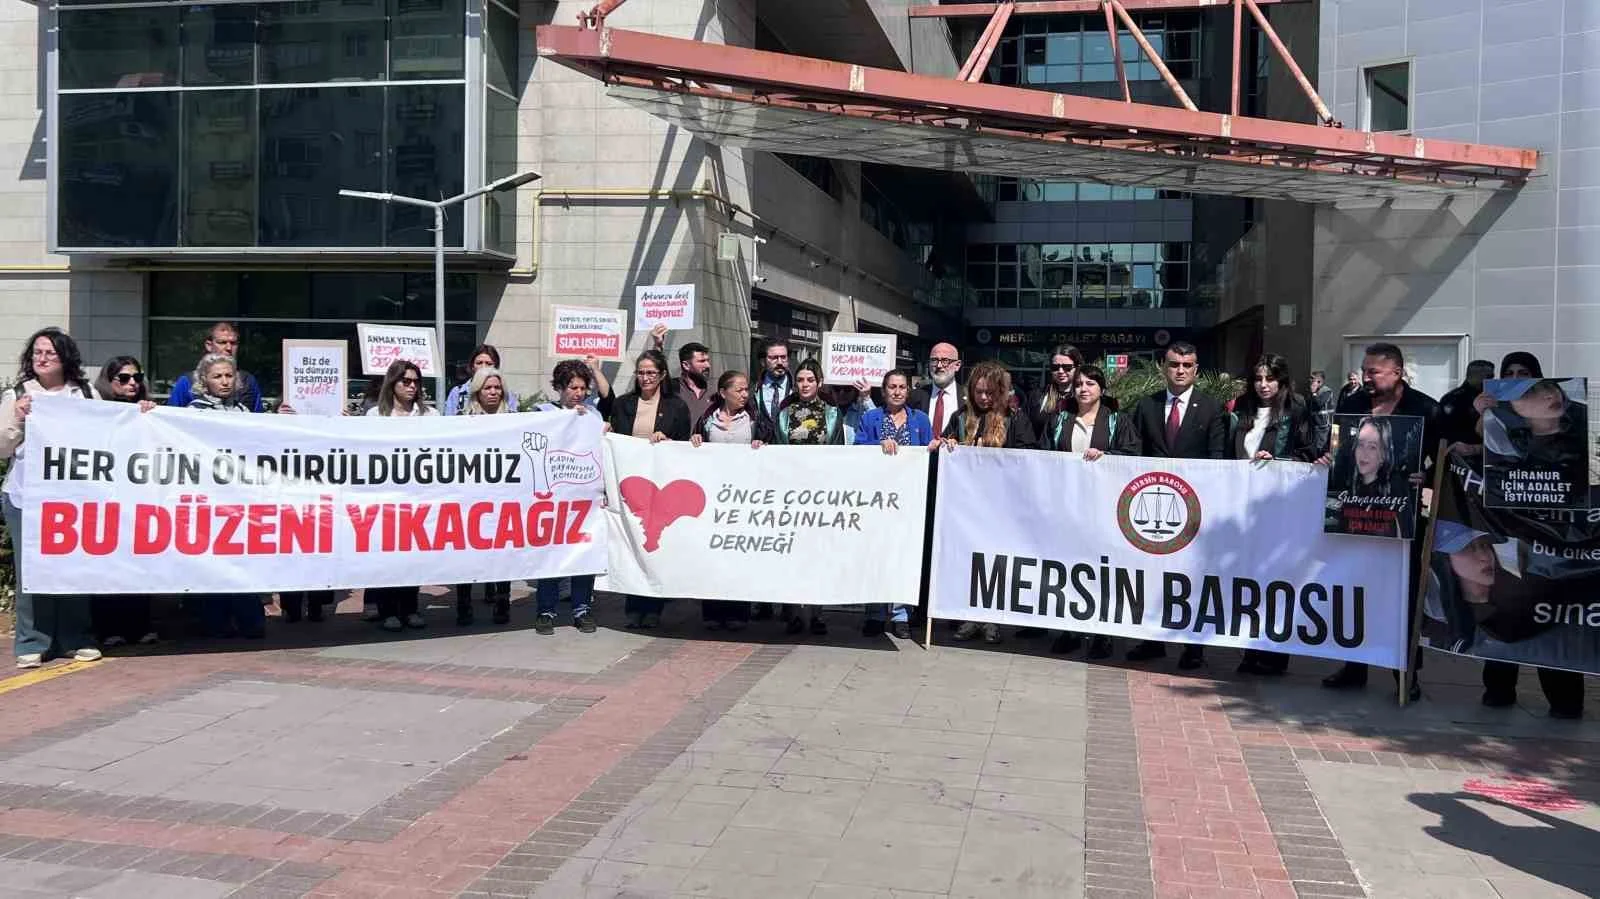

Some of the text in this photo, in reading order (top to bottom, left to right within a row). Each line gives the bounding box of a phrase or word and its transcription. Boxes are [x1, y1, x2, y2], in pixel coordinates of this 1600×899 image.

[645, 308, 684, 319] istiyoruz!
[367, 335, 427, 346] ANMAK YETMEZ
[832, 342, 887, 354] SİZİ YENECEĞİZ
[302, 356, 331, 366] Biz de
[305, 367, 339, 375] dünyaya
[294, 375, 339, 385] yaşamaya
[43, 446, 522, 486] HER GÜN ÖLDÜRÜLDÜĞÜMÜZ
[549, 455, 576, 464] KADIN
[1508, 469, 1560, 481] HİRANUR
[1130, 476, 1188, 495] MERSİN BAROSU
[1501, 480, 1572, 493] İÇİN ADALET
[716, 483, 900, 511] ÖNCE ÇOCUKLAR
[1504, 491, 1566, 504] İSTİYORUZ
[39, 492, 592, 556] BU DÜZENİ YIKACAĞIZ
[713, 508, 861, 531] VE KADINLAR
[709, 531, 796, 555] DERNEĞİ
[1532, 540, 1557, 557] bu
[969, 552, 1366, 648] MERSİN BAROSU
